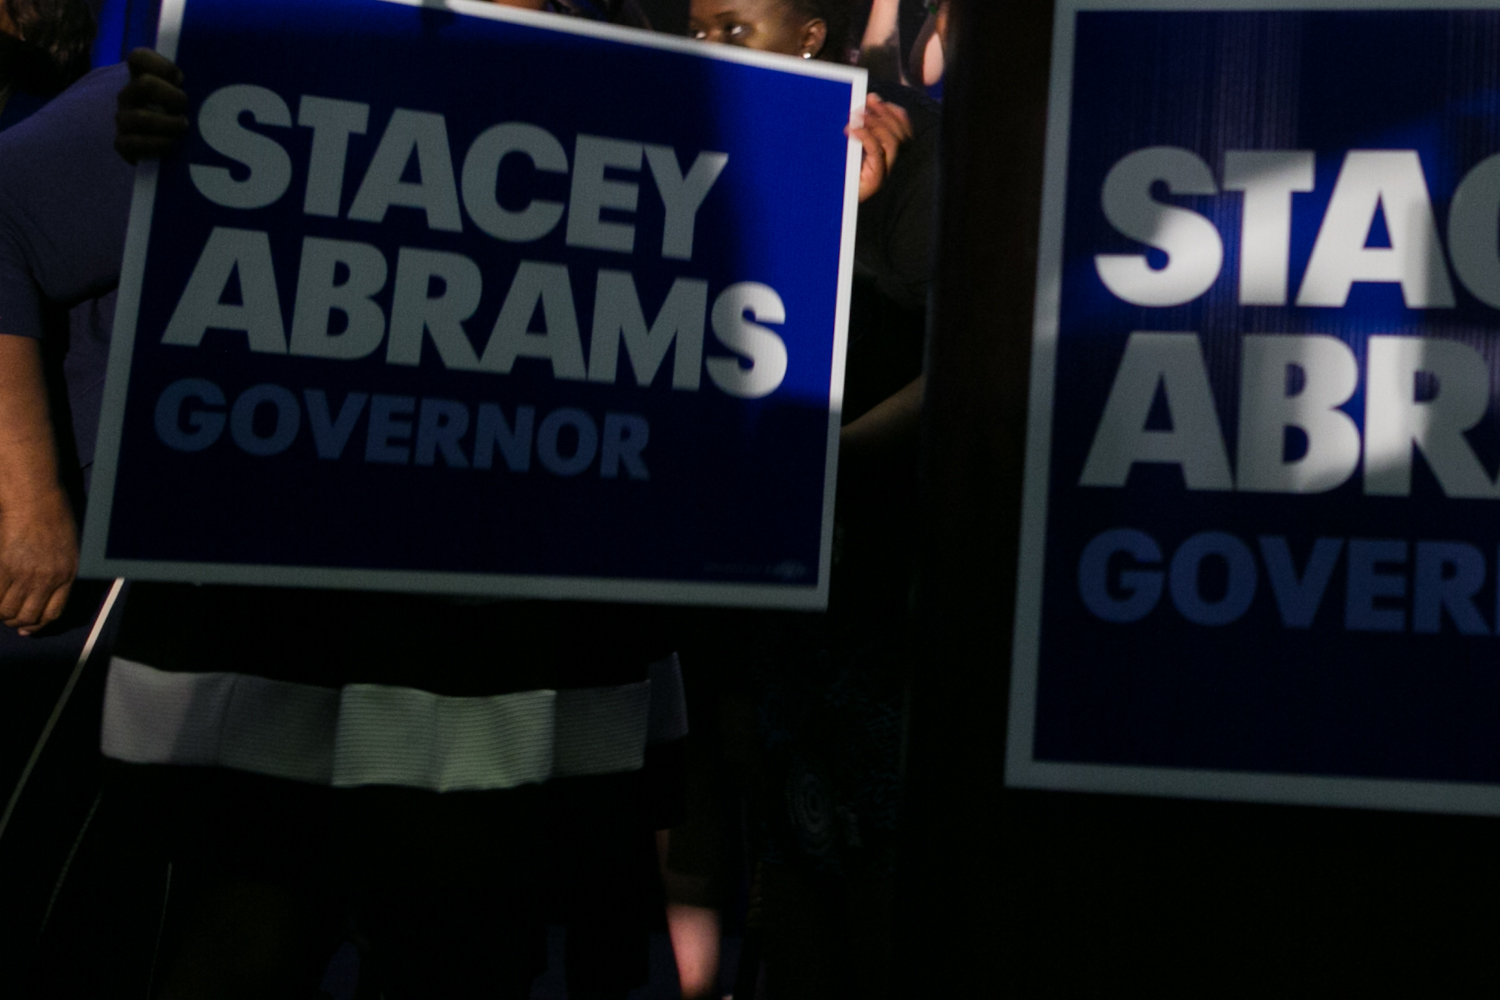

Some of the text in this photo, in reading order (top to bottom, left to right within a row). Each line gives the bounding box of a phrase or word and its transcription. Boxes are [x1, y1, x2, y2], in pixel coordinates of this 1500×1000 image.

[188, 84, 729, 260] STACEY
[160, 226, 788, 398] ABRAMS
[154, 377, 651, 480] GOVERNOR
